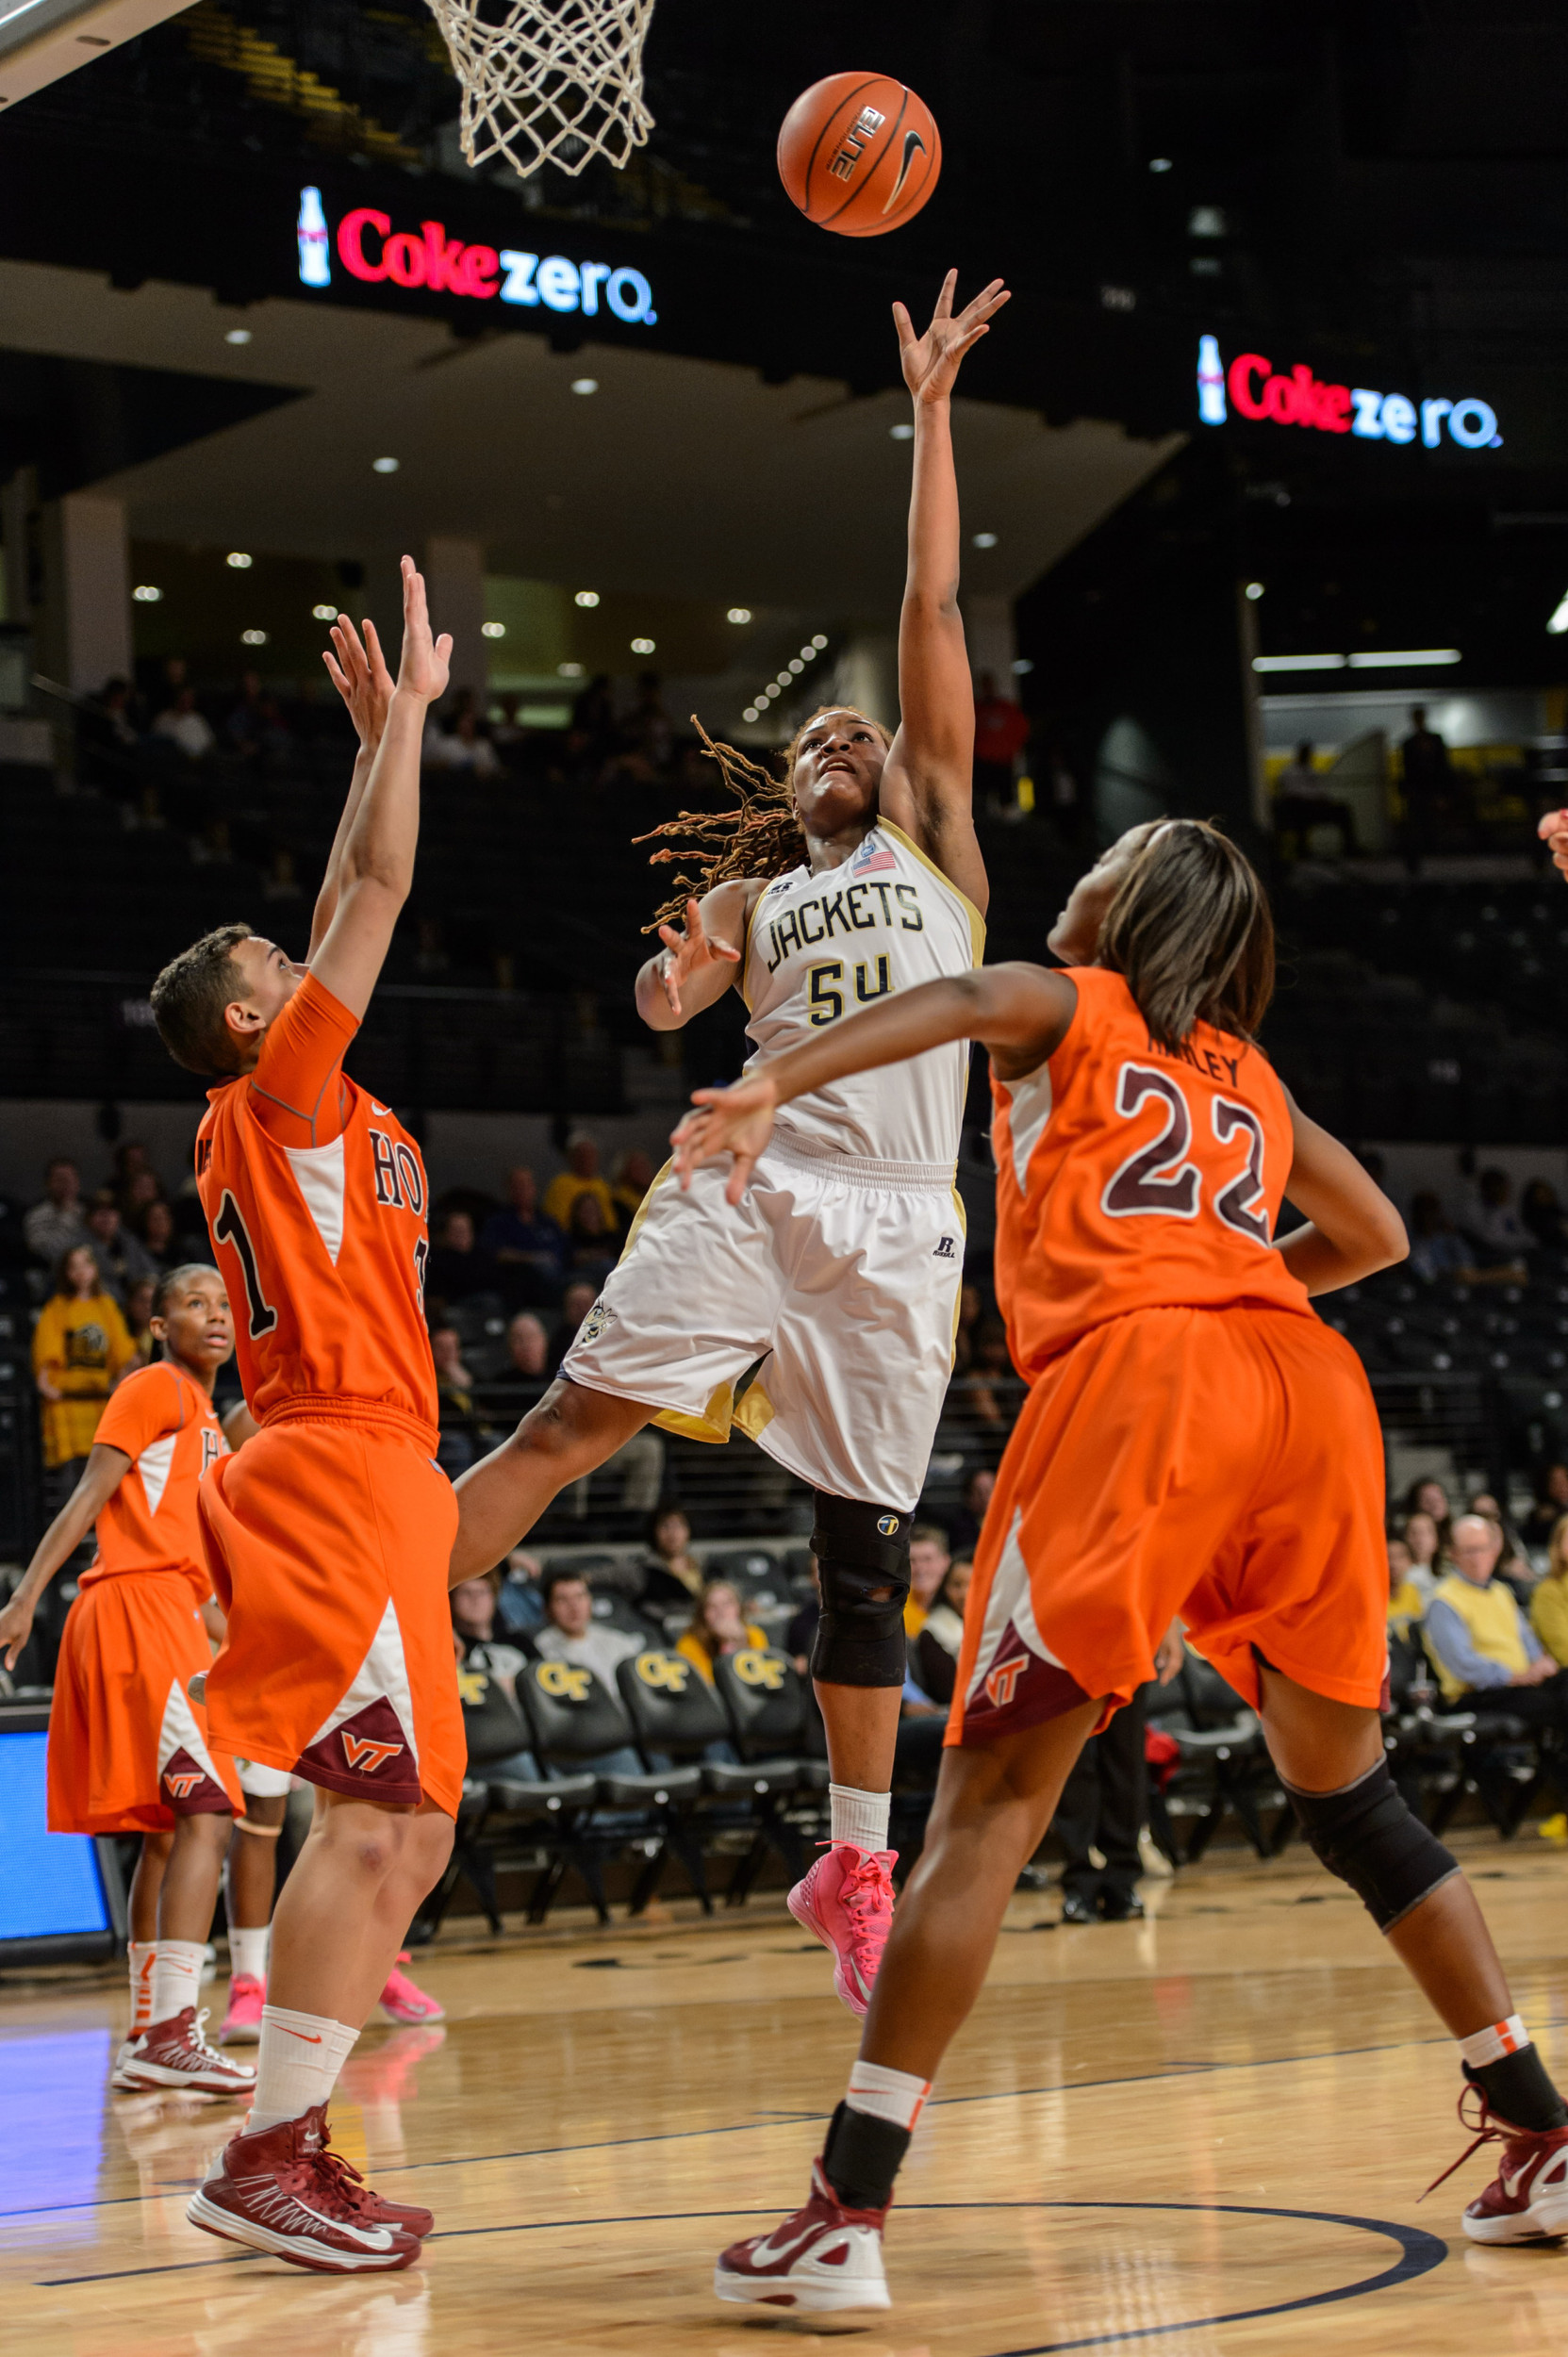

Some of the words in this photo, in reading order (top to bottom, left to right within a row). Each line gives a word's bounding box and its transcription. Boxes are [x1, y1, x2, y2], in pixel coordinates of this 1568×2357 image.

[831, 106, 886, 183] ELITE
[337, 207, 500, 300] Coke
[499, 249, 657, 326] zero
[1228, 353, 1353, 434] Coke
[1349, 387, 1504, 449] zero
[767, 881, 924, 975] JACKETS
[807, 952, 897, 1029] 54
[368, 1128, 428, 1225] HO
[1101, 1061, 1273, 1242] 22
[213, 1188, 279, 1341] 1
[163, 1772, 206, 1798] VT
[340, 1731, 404, 1772] VT
